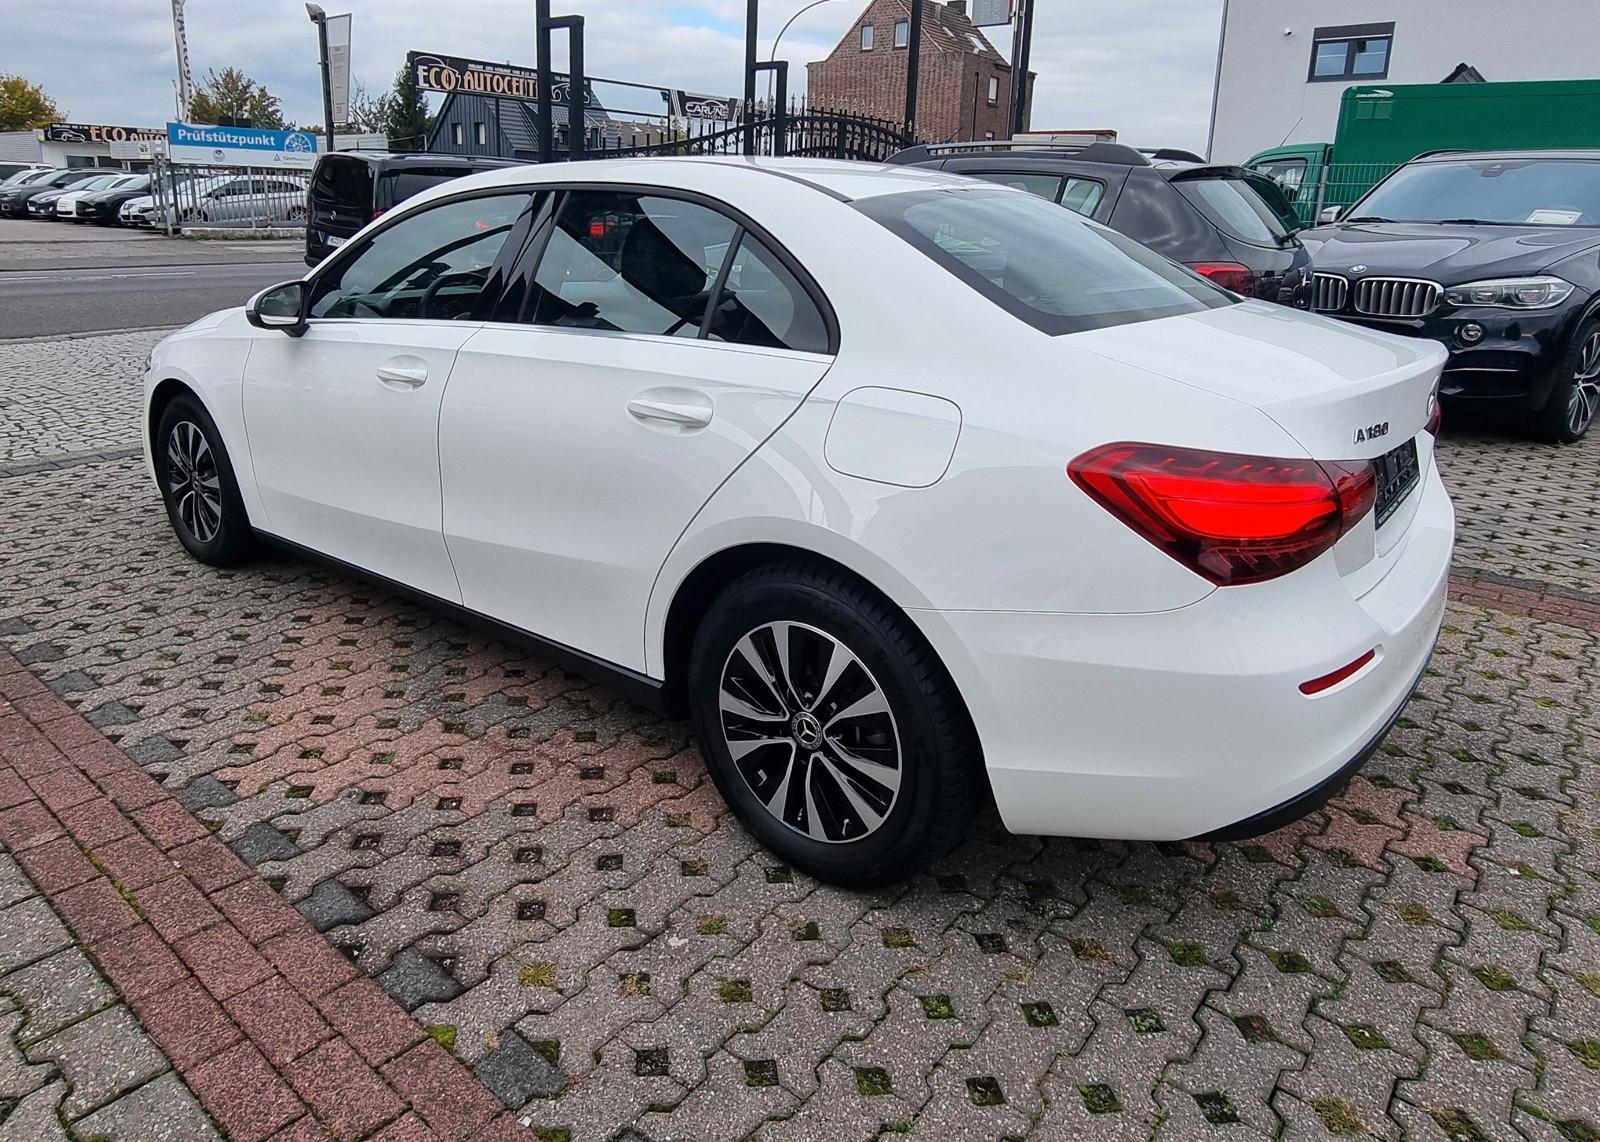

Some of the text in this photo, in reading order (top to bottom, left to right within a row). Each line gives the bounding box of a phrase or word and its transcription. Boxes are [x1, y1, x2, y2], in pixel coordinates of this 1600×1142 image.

[417, 64, 456, 91] ECO
[90, 126, 168, 143] ECO AUTO
[178, 128, 277, 146] Prüfstützpunkt
